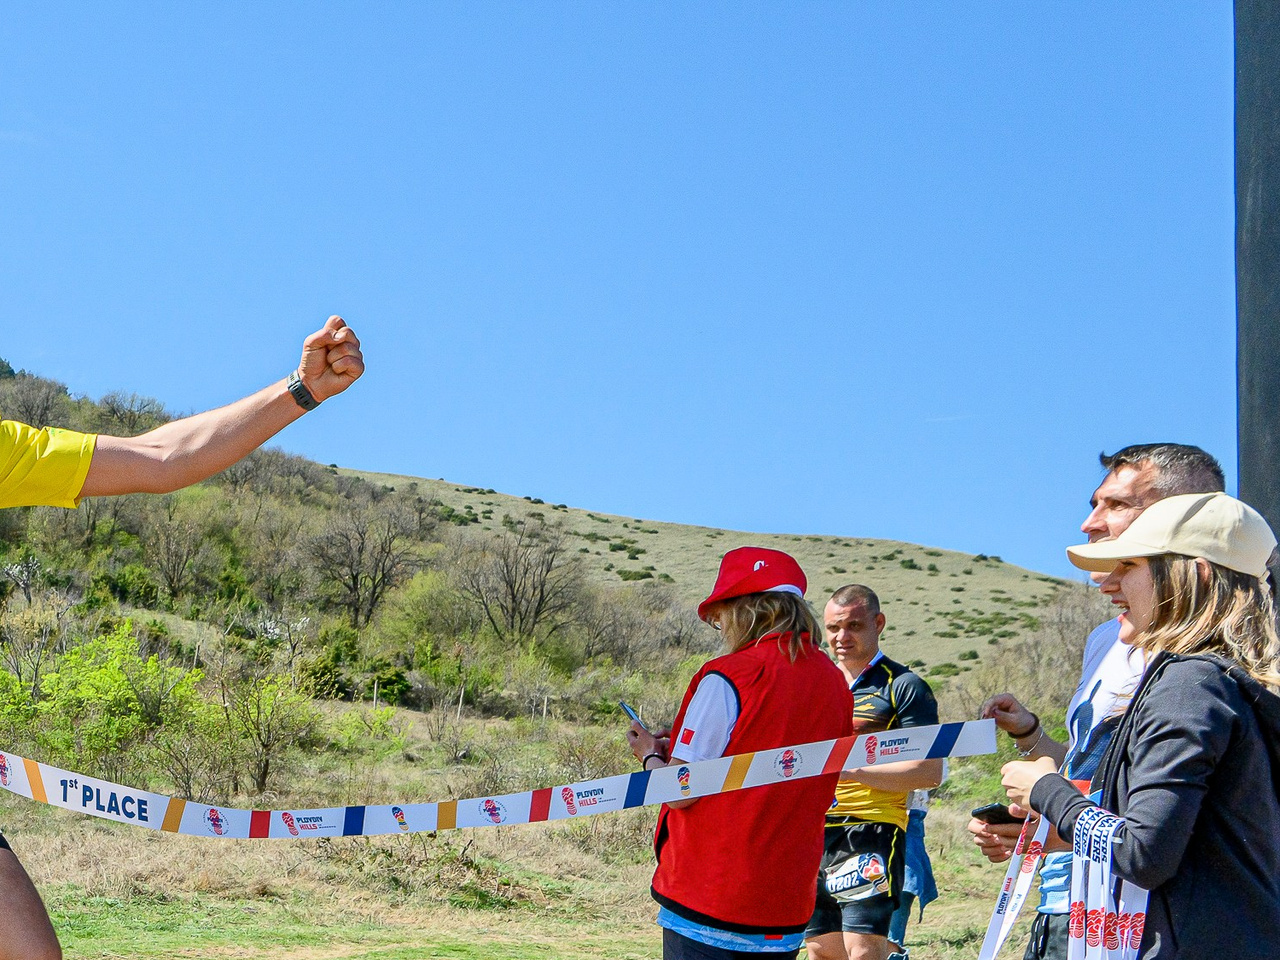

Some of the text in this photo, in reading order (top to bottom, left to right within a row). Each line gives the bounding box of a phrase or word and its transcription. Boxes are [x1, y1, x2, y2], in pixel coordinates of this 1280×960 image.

[880, 737, 909, 748] PLOVDIV
[880, 746, 899, 756] HILLS
[576, 788, 604, 799] PLOVDIV
[60, 778, 148, 822] 1st PLACE
[578, 797, 597, 807] HILLS
[1074, 808, 1095, 857] MATTERS
[1092, 818, 1113, 863] MATTERS
